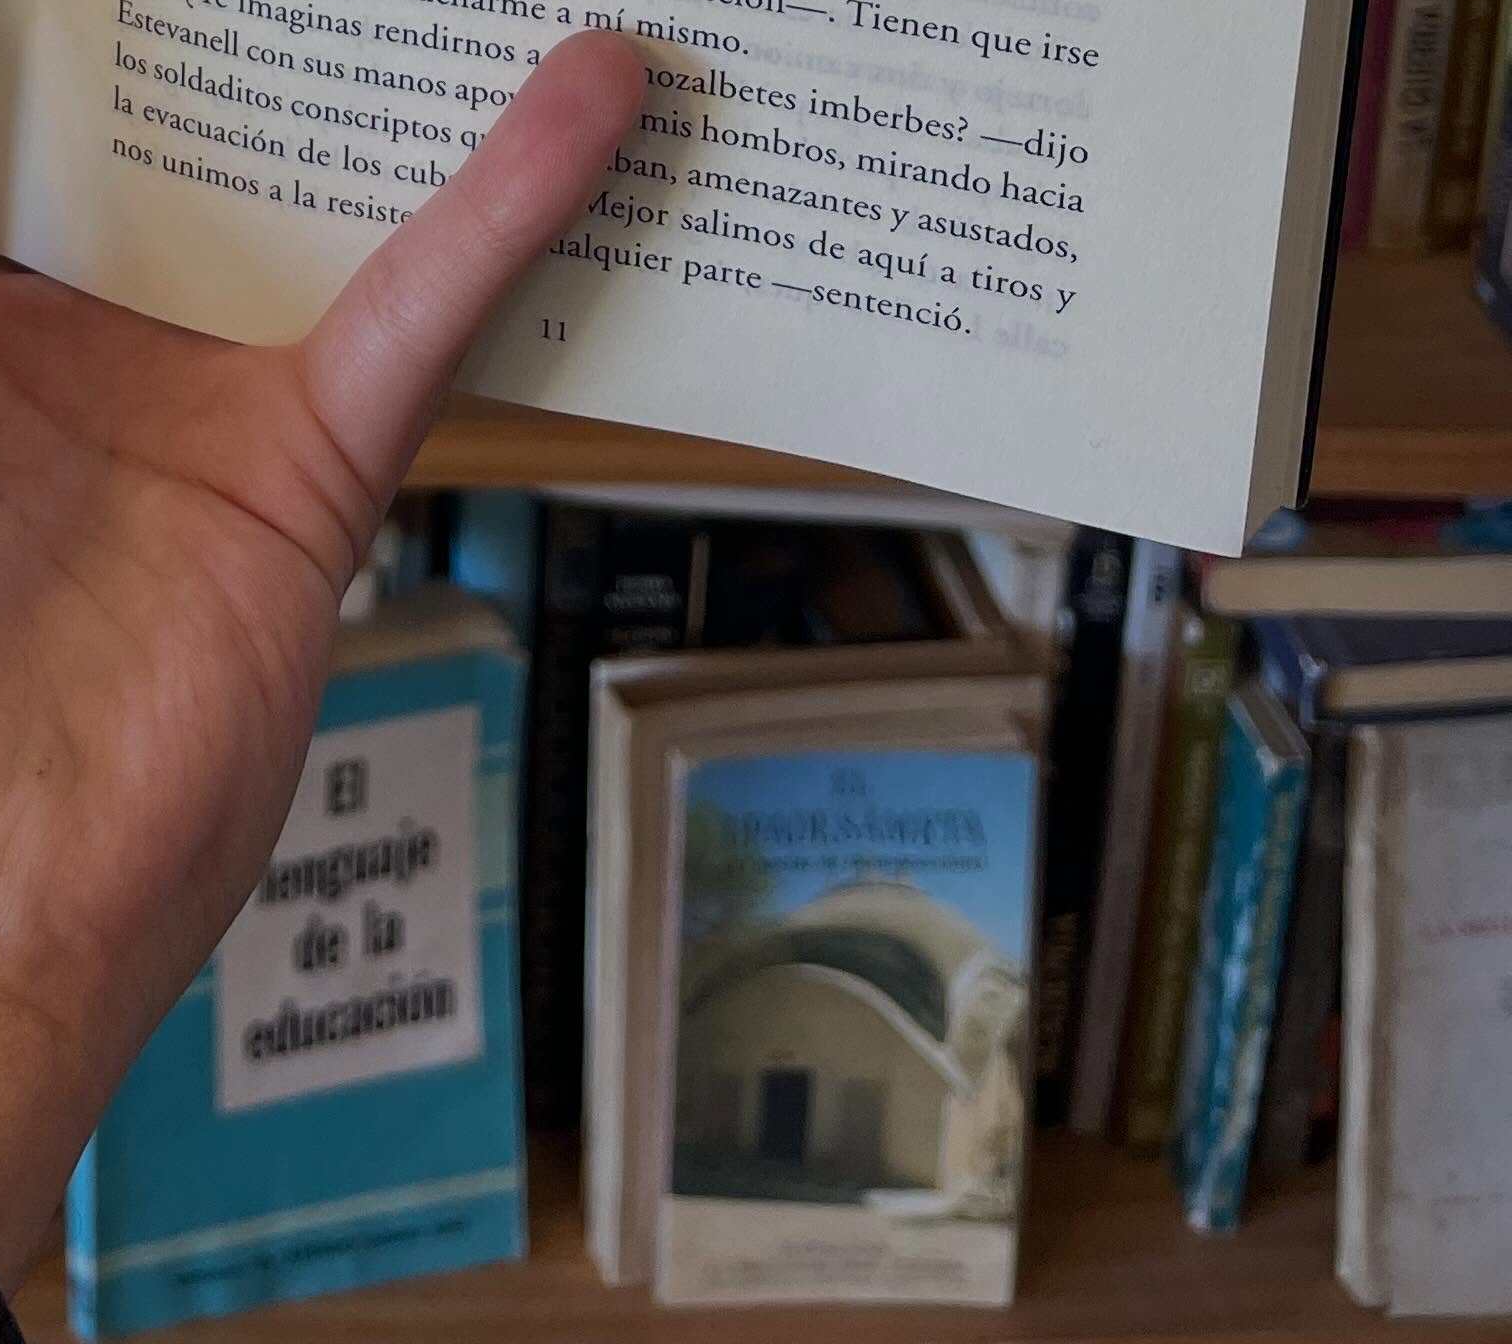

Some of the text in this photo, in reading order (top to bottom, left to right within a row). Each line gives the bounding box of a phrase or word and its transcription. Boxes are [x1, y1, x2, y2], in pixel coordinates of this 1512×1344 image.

[847, 0, 959, 43] Tienen
[972, 31, 1031, 58] que
[1042, 33, 1099, 66] irse
[374, 24, 514, 61] rendirnos
[527, 50, 539, 64] a
[809, 89, 968, 142] imberbes?
[980, 129, 1088, 168] —dijo
[543, 319, 565, 341] 11
[324, 756, 370, 815] El
[293, 914, 348, 973] de
